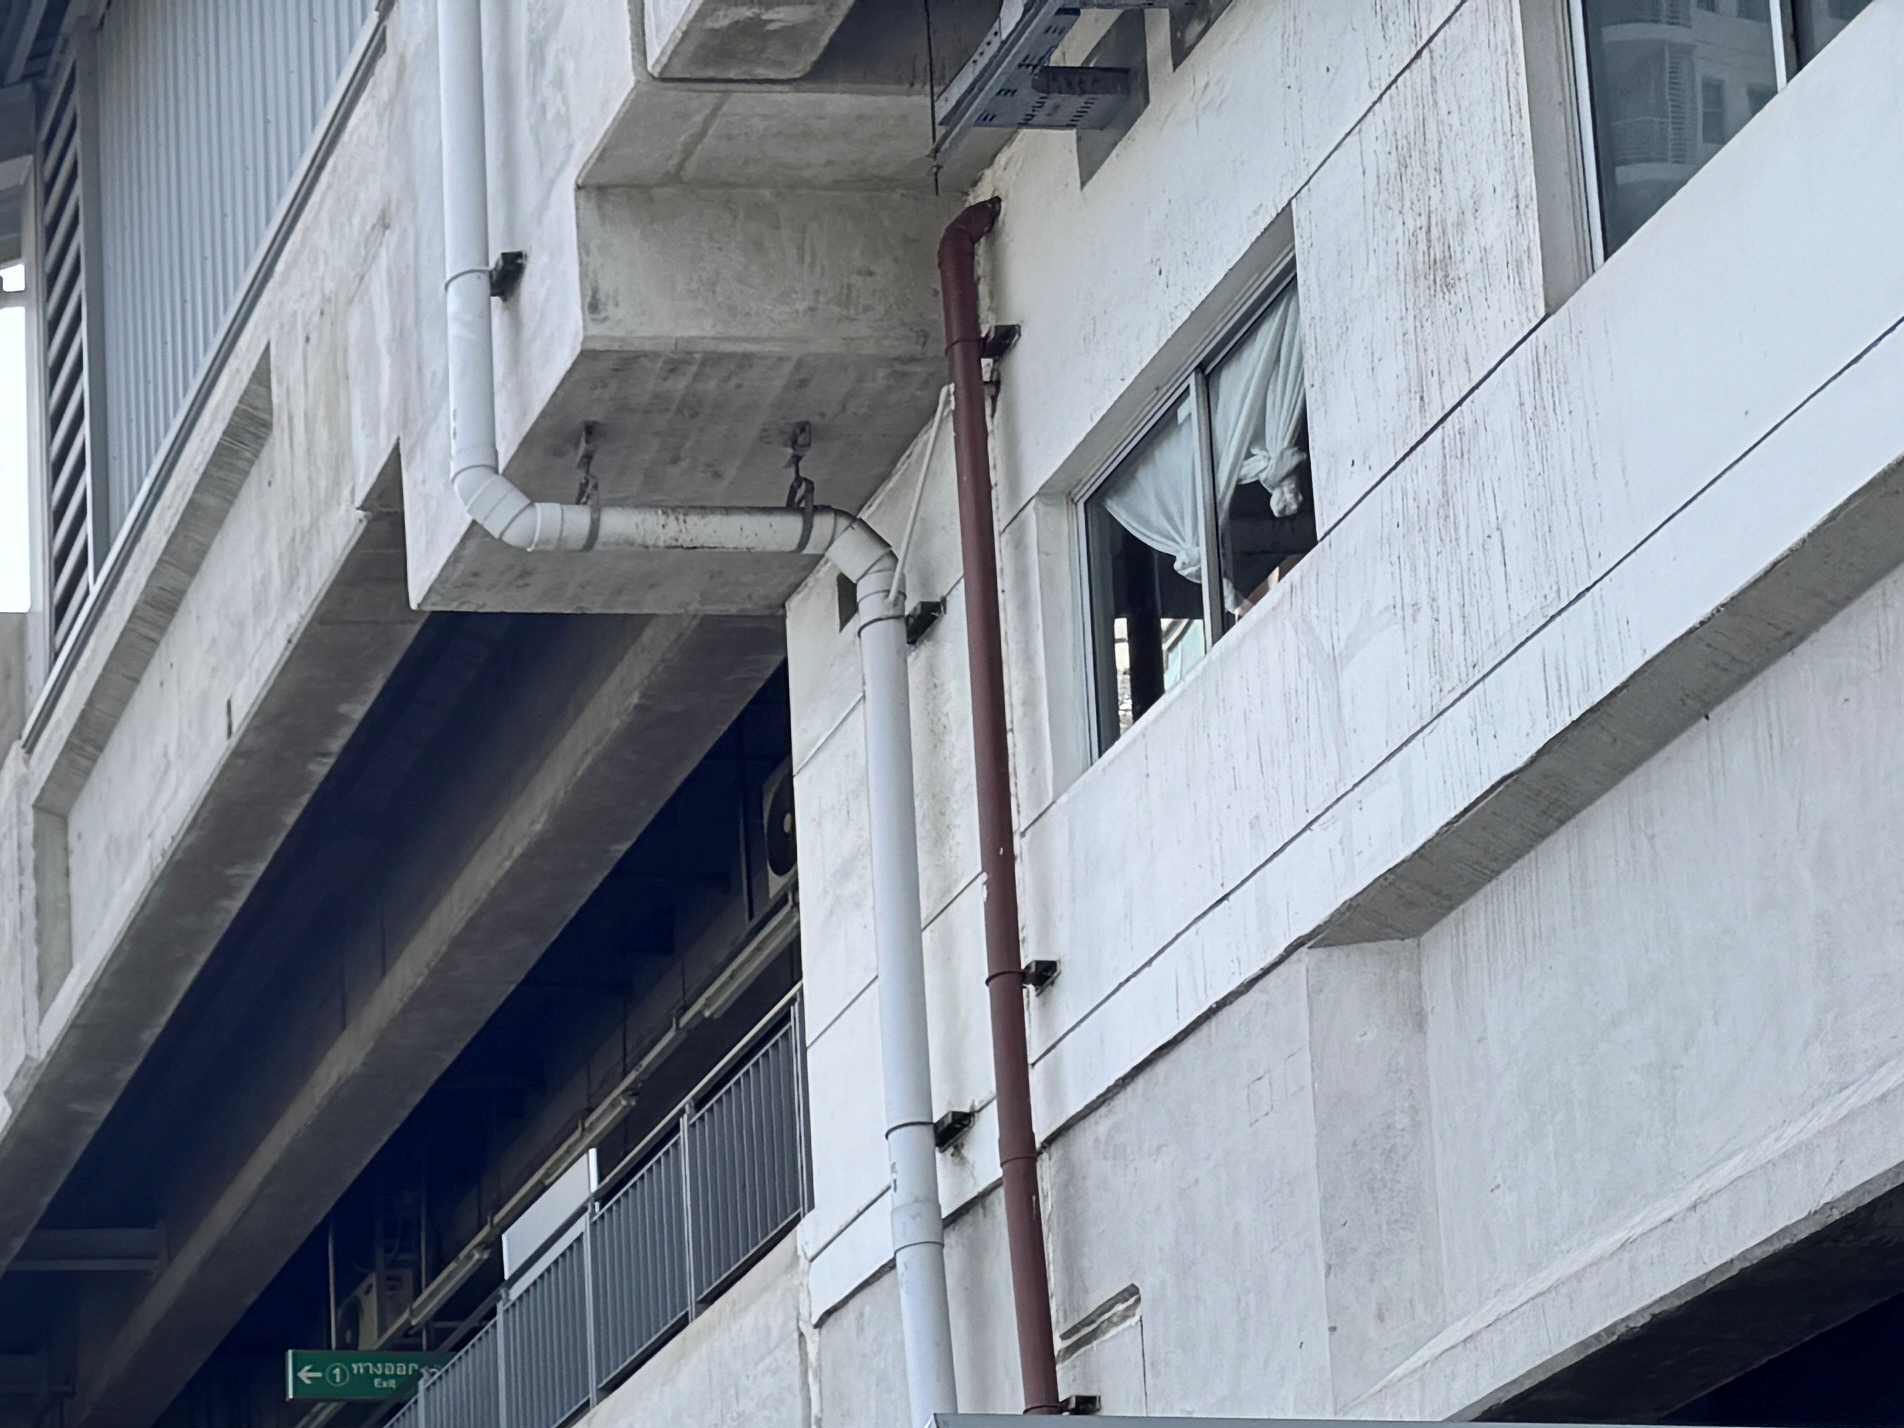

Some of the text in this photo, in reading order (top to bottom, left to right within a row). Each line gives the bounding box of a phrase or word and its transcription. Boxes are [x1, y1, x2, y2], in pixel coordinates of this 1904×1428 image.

[352, 1362, 418, 1376] ทางออก
[374, 1378, 396, 1389] Exit
